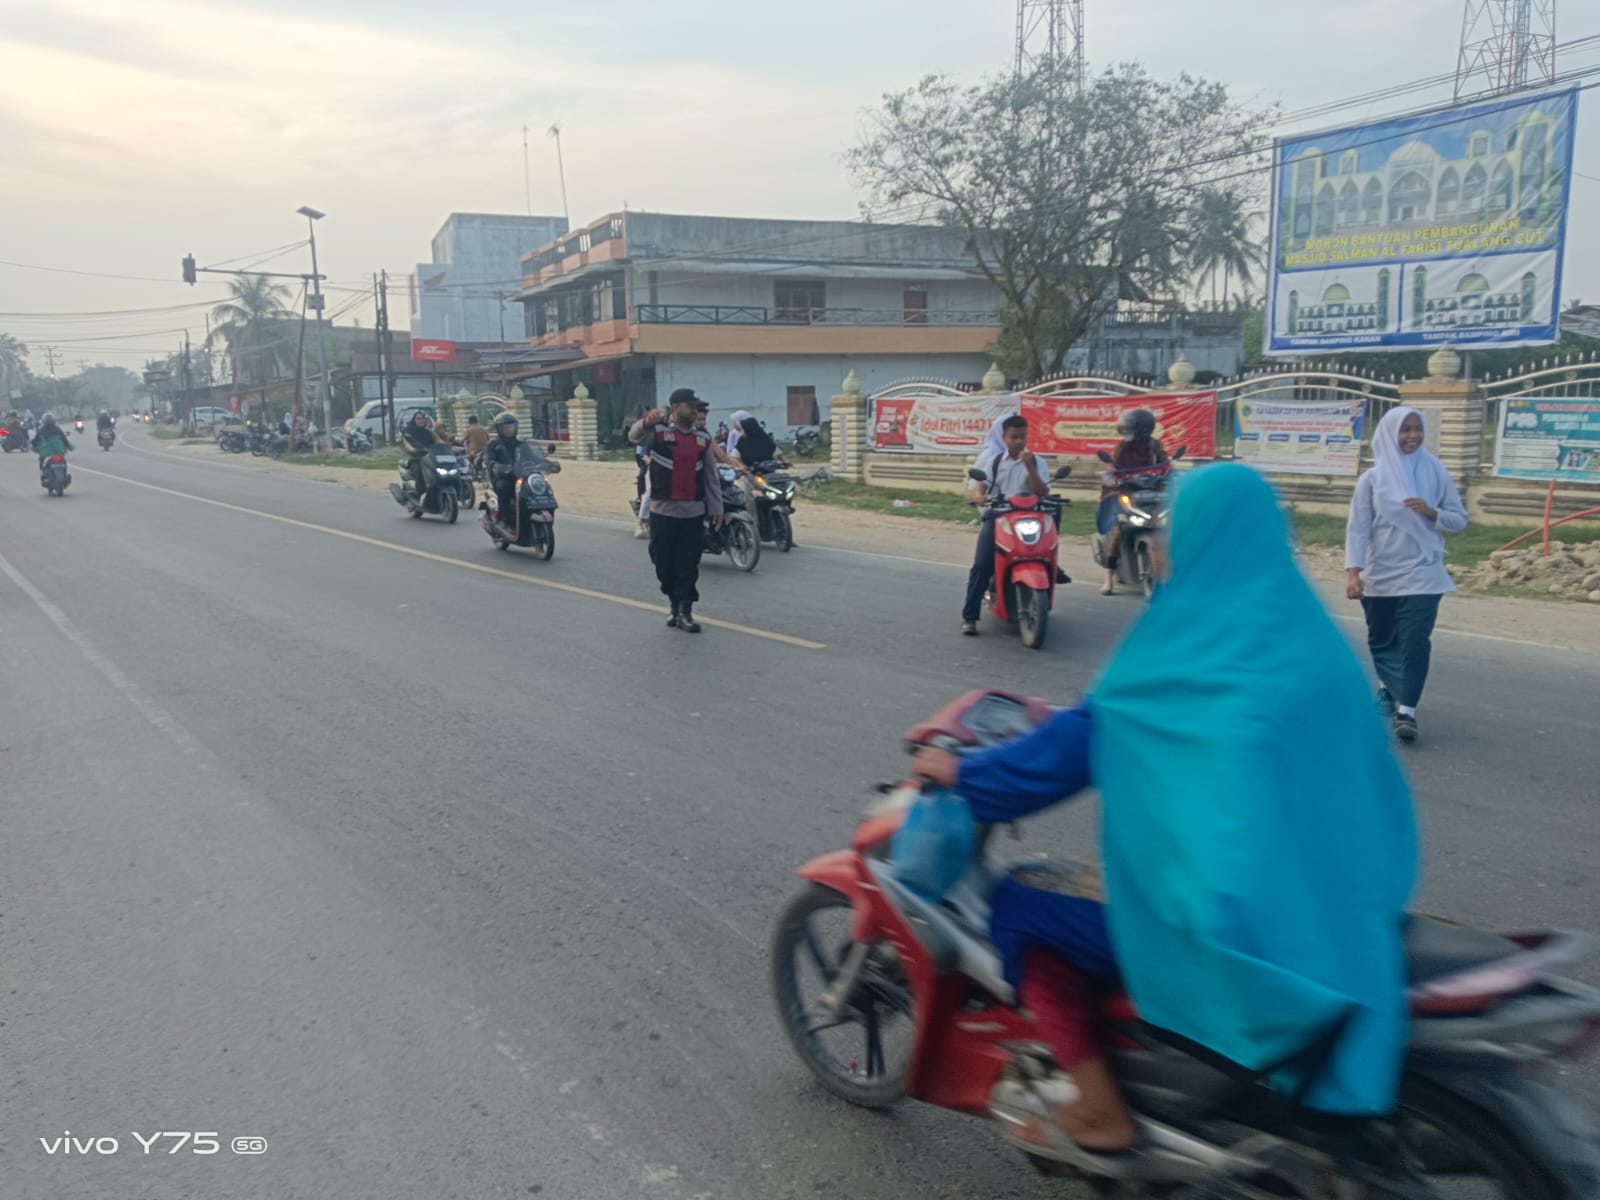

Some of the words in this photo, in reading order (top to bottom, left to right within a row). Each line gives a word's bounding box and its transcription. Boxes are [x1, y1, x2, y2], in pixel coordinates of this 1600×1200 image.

[1285, 252, 1326, 267] MASJID
[1330, 247, 1377, 262] SALMAN
[1381, 246, 1396, 257] AL
[1401, 241, 1441, 255] FARISI
[1446, 235, 1511, 251] TUALANG
[1514, 229, 1545, 245] CUT
[1305, 236, 1347, 250] MOHON
[1351, 231, 1410, 246] BANTUAN
[1414, 218, 1520, 239] PEMBANGUNAN
[920, 418, 938, 432] Idul
[941, 417, 960, 432] Fitri
